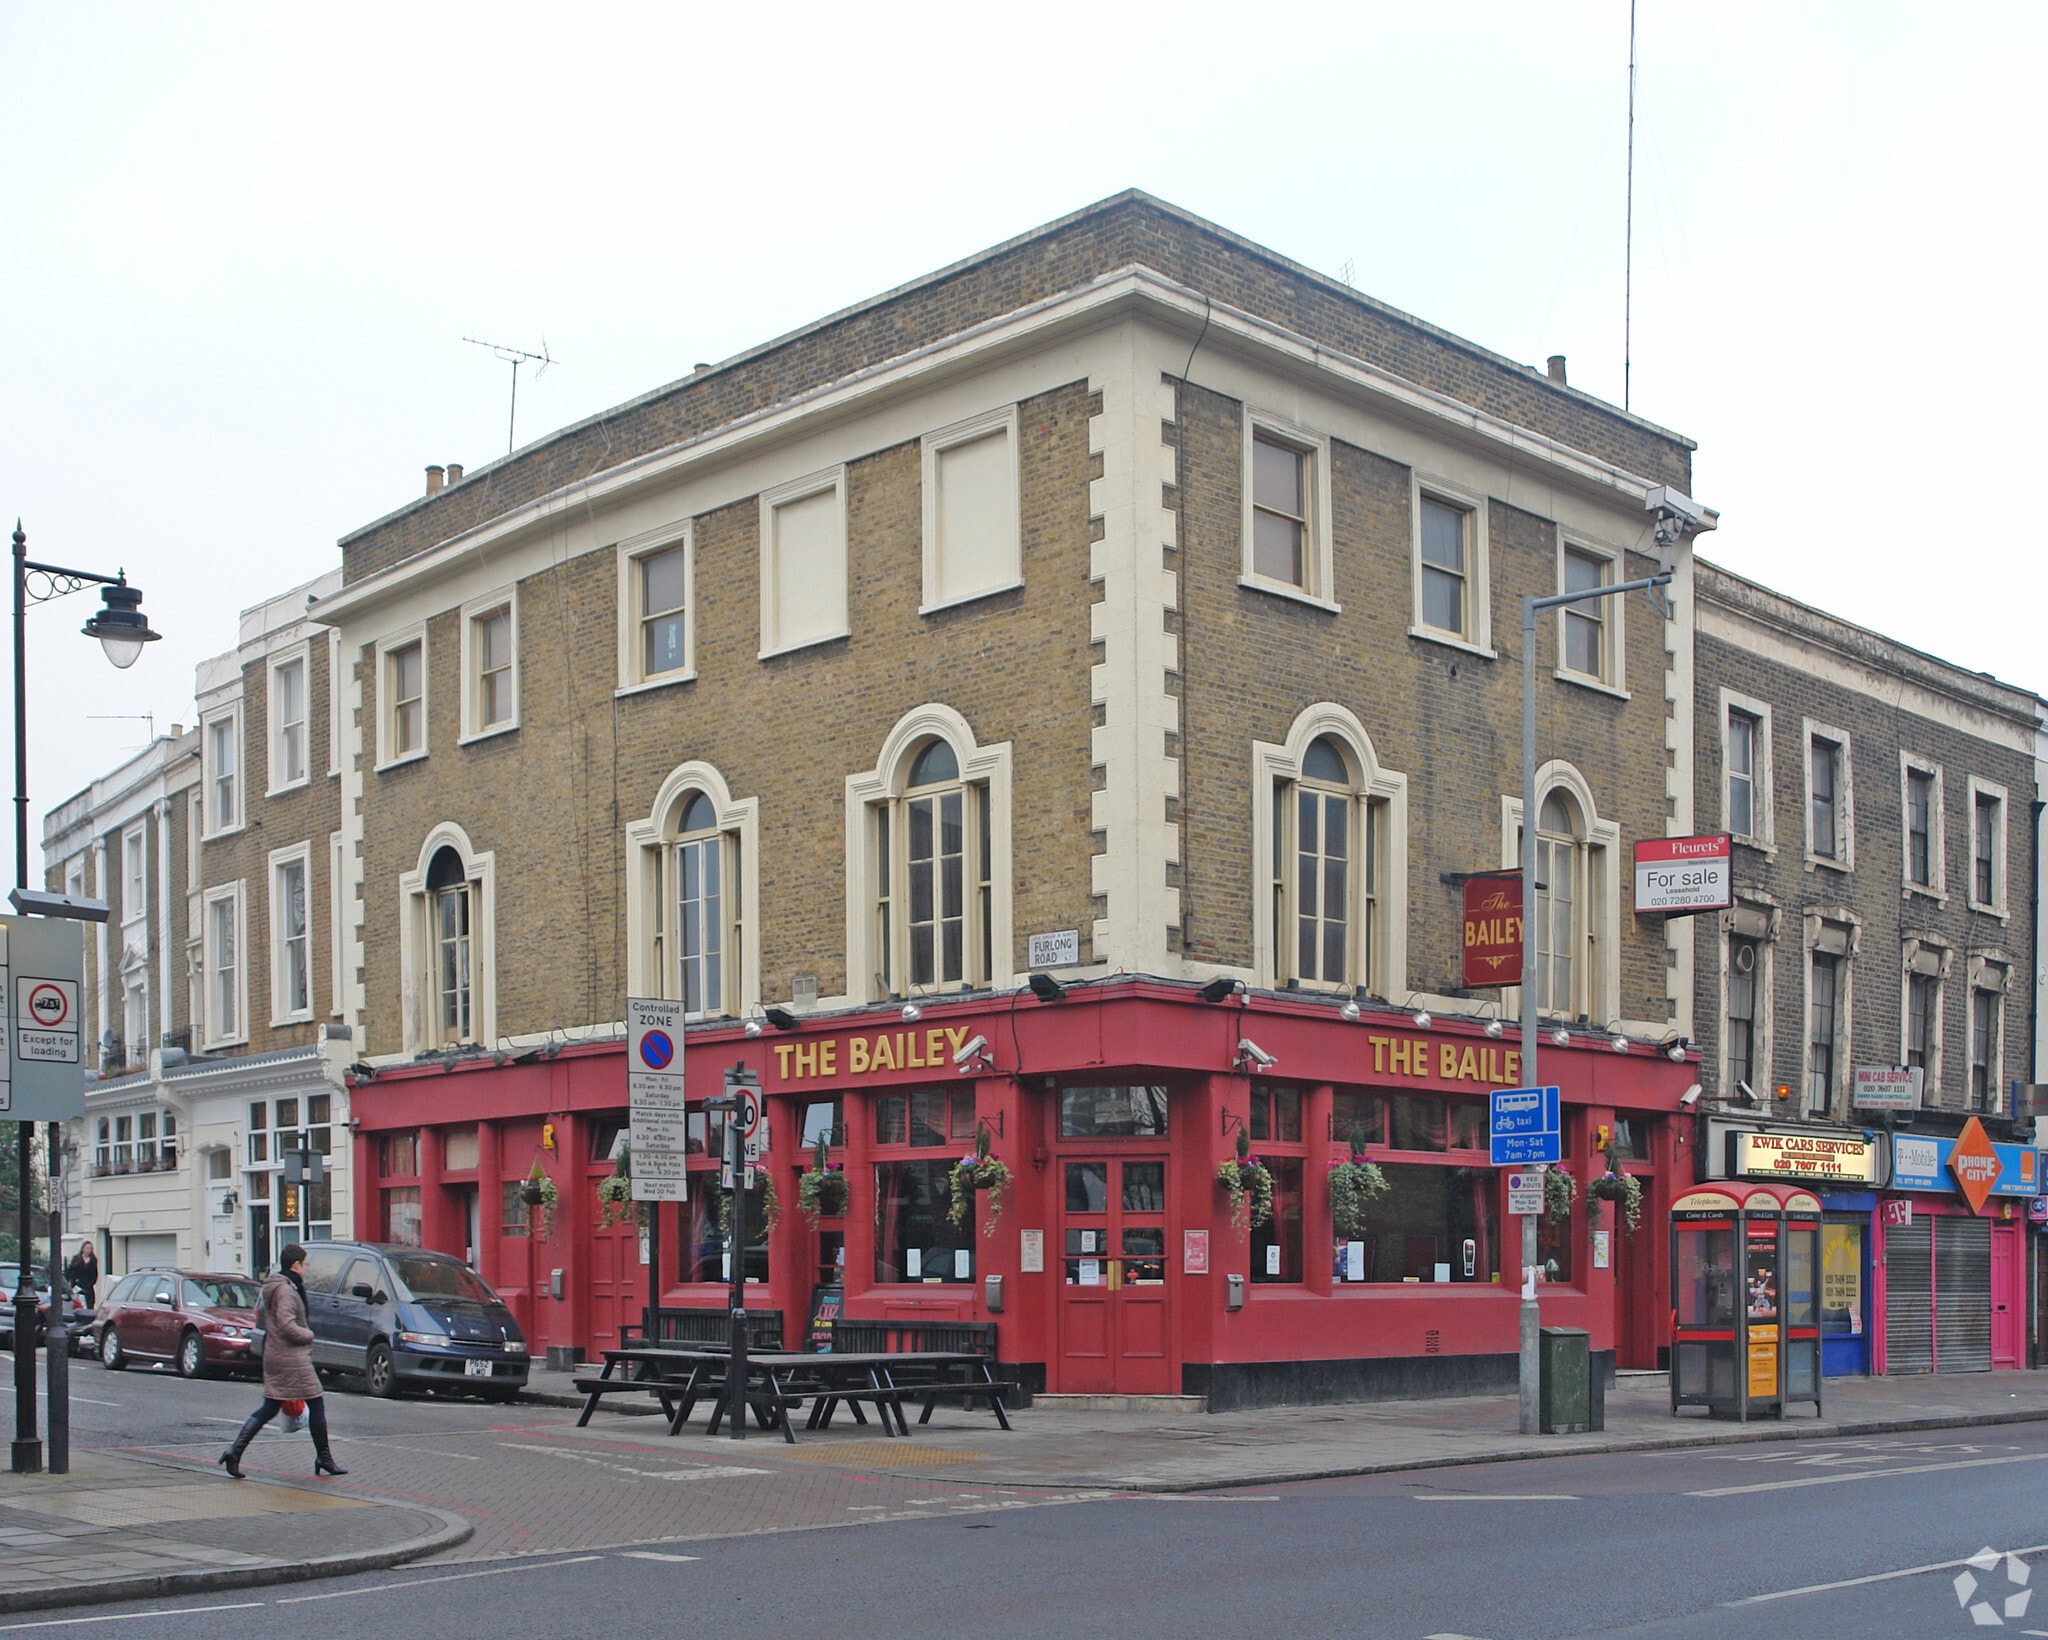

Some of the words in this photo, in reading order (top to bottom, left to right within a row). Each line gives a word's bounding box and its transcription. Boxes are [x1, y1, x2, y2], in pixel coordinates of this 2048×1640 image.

[1672, 842, 1719, 854] Fleurets
[1647, 871, 1675, 887] For
[1681, 868, 1718, 885] sale
[1665, 886, 1700, 894] Leasehold
[1481, 892, 1510, 912] The
[1651, 898, 1667, 906] 020
[1670, 896, 1691, 905] 7280
[1693, 894, 1715, 903] 4700
[1465, 917, 1523, 947] BAILEY
[1034, 938, 1072, 952] FURLONG
[1034, 952, 1057, 965] ROAD
[632, 1002, 680, 1014] Controlled
[639, 1015, 673, 1027] ZONE
[23, 1034, 56, 1047] Except
[59, 1037, 74, 1046] for
[31, 1046, 67, 1058] loading
[774, 1039, 837, 1080] THE
[849, 1026, 970, 1074] BAILEY
[1368, 1035, 1428, 1077] THE
[1439, 1043, 1523, 1085] BAILE
[1858, 1071, 1871, 1082] MINI
[1872, 1071, 1885, 1083] CAB
[1887, 1071, 1913, 1083] SERVICE
[1893, 1085, 1906, 1093] 1111
[1516, 1116, 1532, 1126] taxi
[1506, 1137, 1544, 1148] Mon-Sat
[1752, 1136, 1783, 1149] KWIK
[1785, 1138, 1814, 1151] CARS
[1815, 1141, 1865, 1156] SERVICES
[1504, 1150, 1546, 1160] 7am-7pm
[1773, 1159, 1791, 1169] 020
[1820, 1162, 1841, 1173] 1111
[1957, 1154, 1996, 1176] PHONE
[1966, 1169, 1987, 1181] CITY
[1689, 1198, 1721, 1206] Telephone
[1888, 1201, 1905, 1225] T
[470, 1360, 489, 1368] P652
